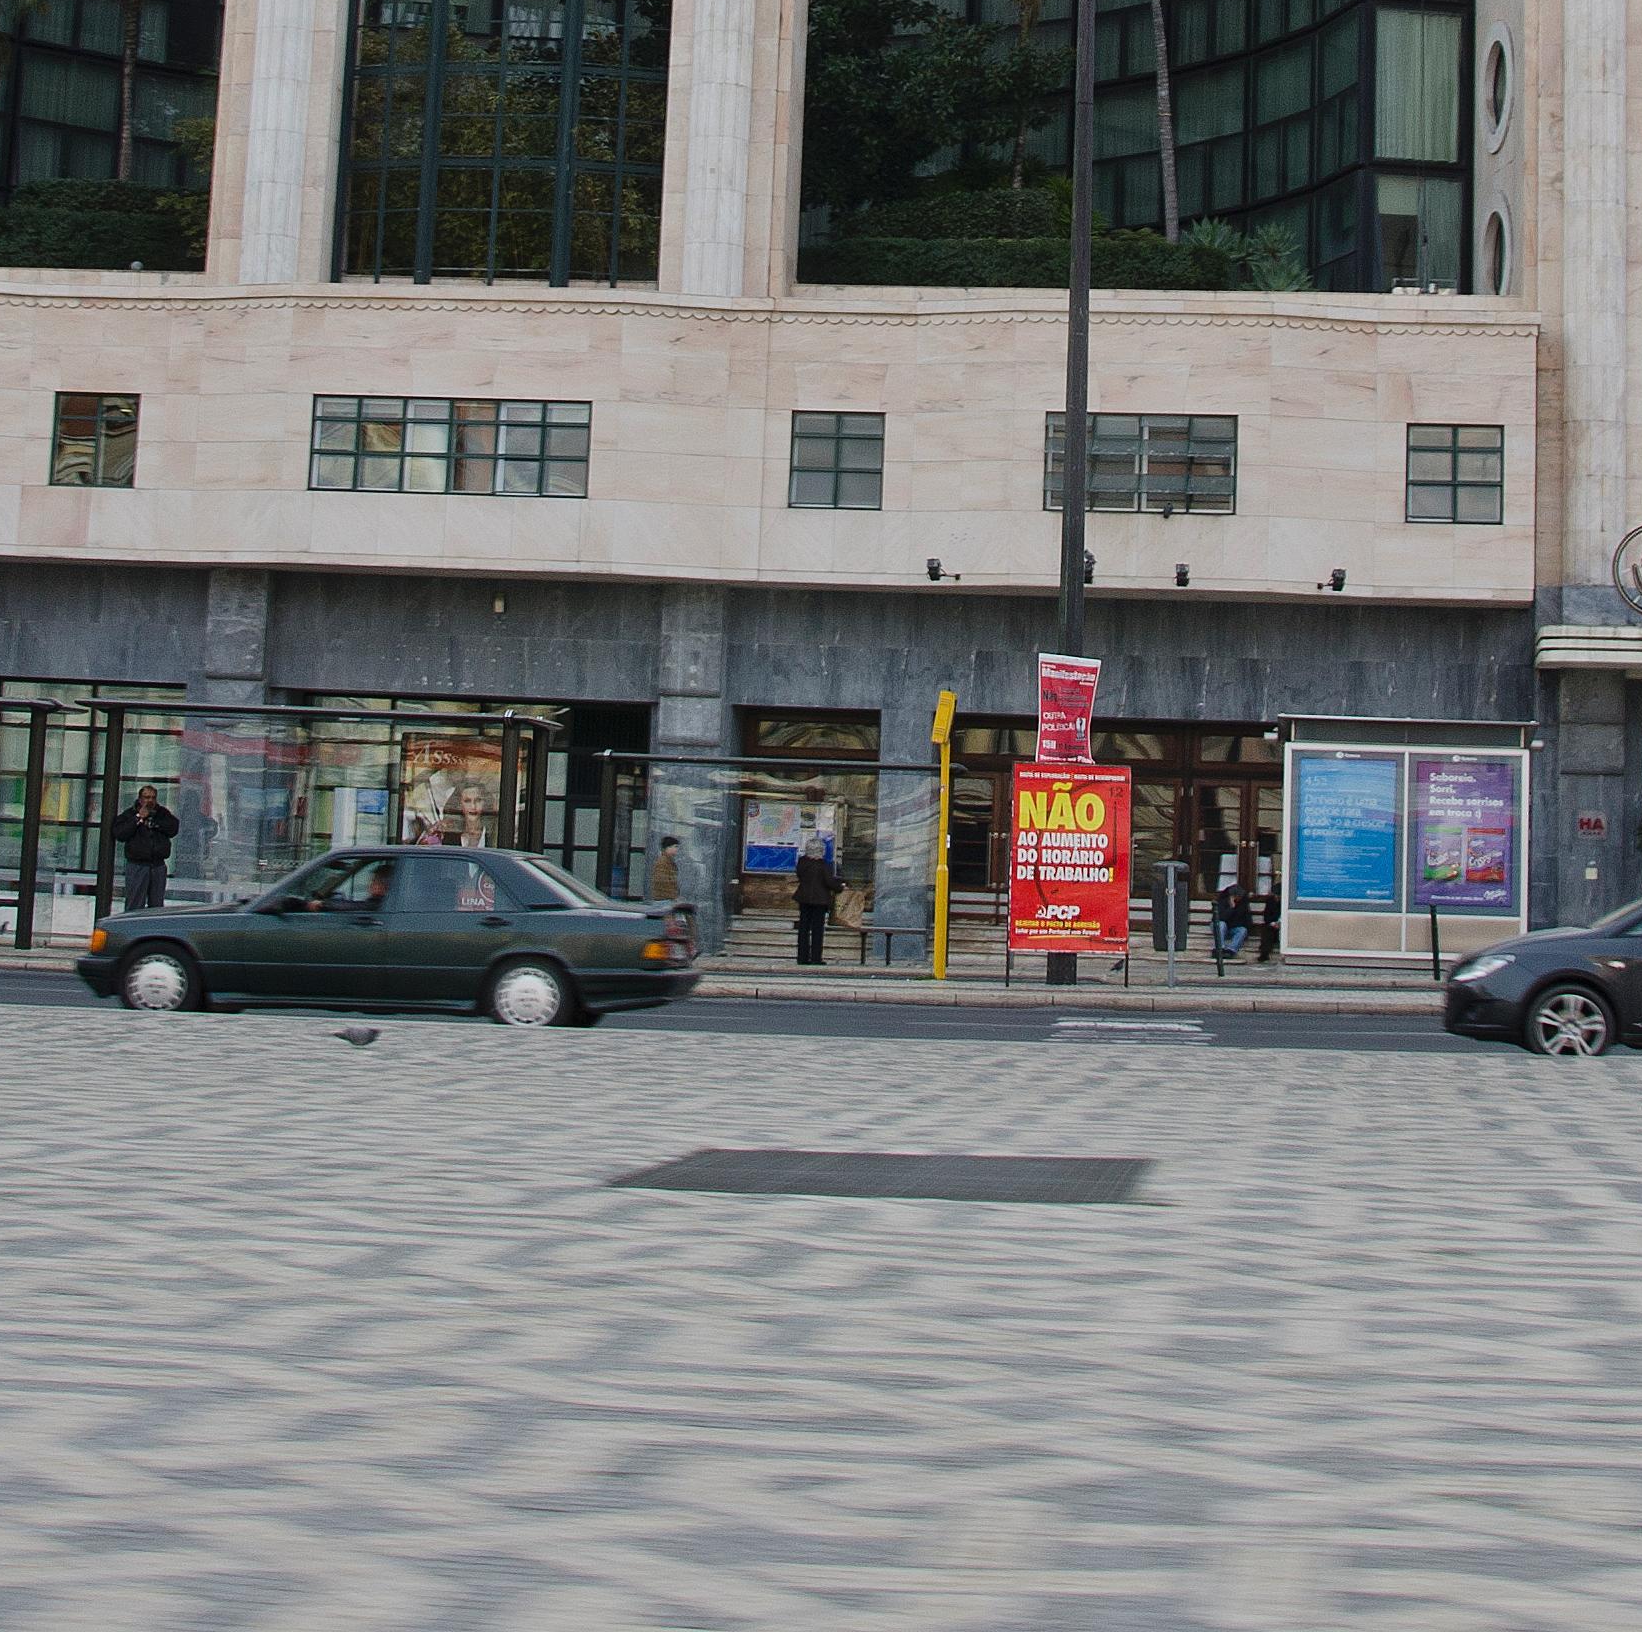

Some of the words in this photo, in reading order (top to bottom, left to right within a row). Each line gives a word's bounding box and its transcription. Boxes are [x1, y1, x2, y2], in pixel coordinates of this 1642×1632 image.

[1429, 772, 1477, 783] Saboreia.
[1018, 781, 1106, 832] NÃO
[1579, 817, 1604, 830] HA
[1017, 831, 1038, 847] AO
[1041, 831, 1109, 848] AUMENTO
[1017, 848, 1038, 864] DO
[1041, 846, 1105, 866] HORÁRIO
[1017, 865, 1035, 881] DE
[1039, 866, 1114, 882] TRABALHO!
[1046, 904, 1081, 920] PCP
